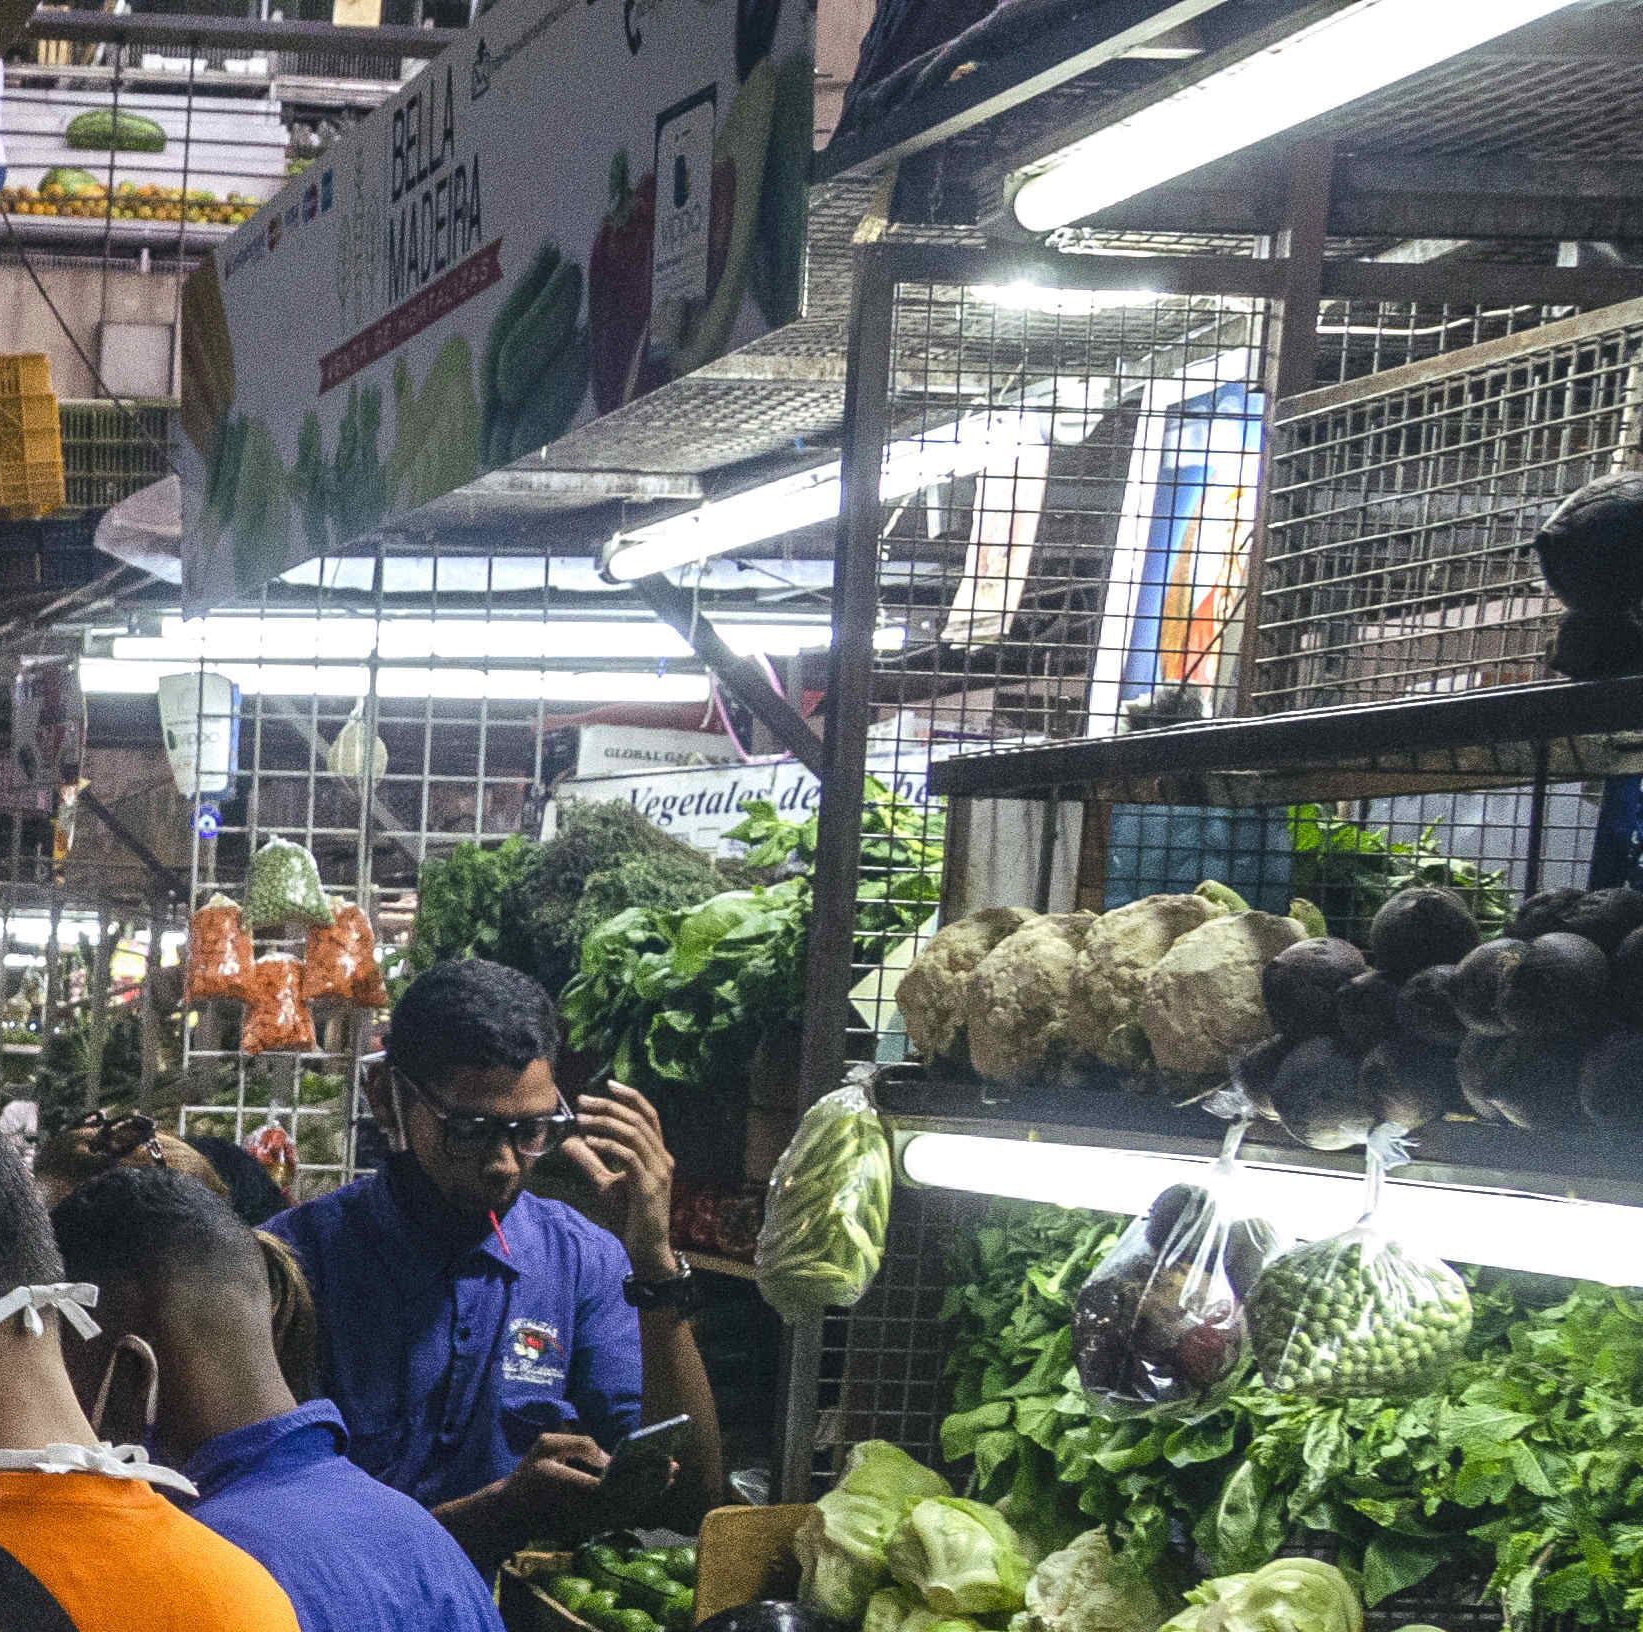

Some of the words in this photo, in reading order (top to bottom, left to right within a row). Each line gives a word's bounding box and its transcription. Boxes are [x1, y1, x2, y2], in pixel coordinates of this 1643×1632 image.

[392, 64, 456, 204] BELLA
[388, 152, 483, 304] MADEIRA
[778, 774, 822, 812] de
